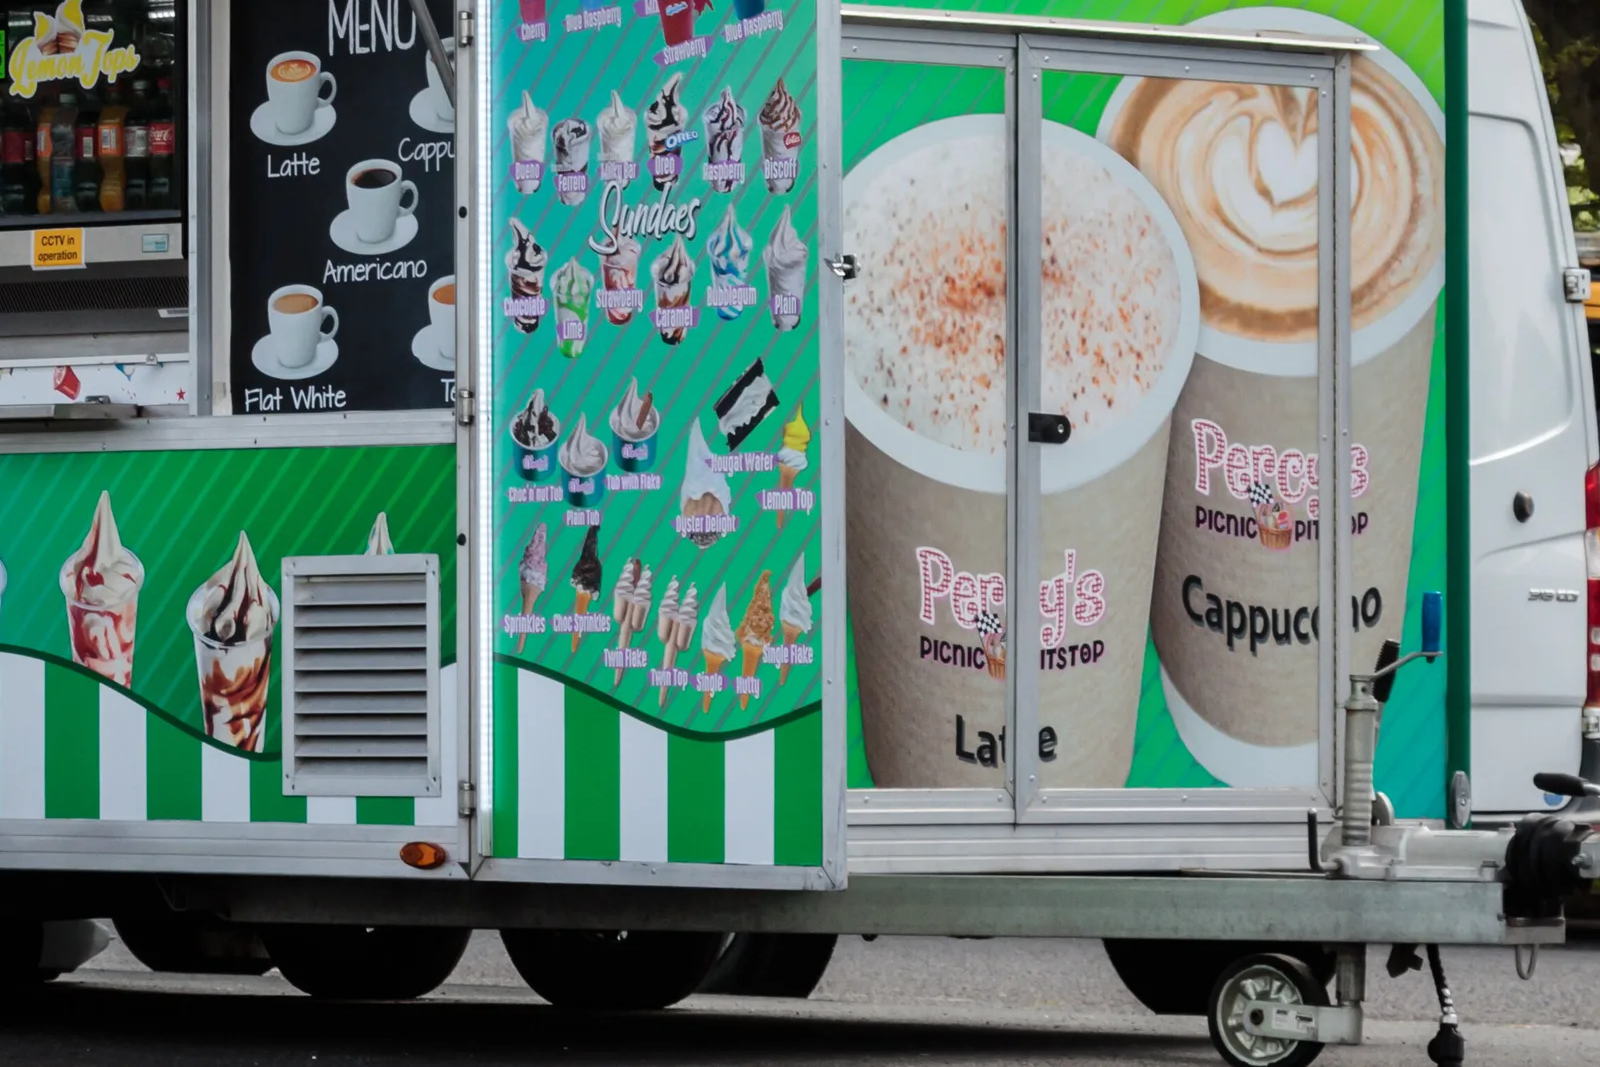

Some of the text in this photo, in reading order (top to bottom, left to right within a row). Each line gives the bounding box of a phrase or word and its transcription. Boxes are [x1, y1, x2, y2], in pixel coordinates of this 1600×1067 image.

[521, 22, 545, 42] Cherry
[725, 10, 783, 42] Blue Raspberry
[664, 37, 706, 64] Strawberry
[9, 28, 140, 99] Lemon Tops
[666, 131, 698, 148] OREO
[267, 153, 321, 178] Latte
[516, 163, 539, 180] Bueno
[655, 156, 674, 174] Oreo
[703, 163, 745, 184] Raspberry
[765, 159, 796, 179] Biscoff
[559, 176, 585, 191] Ferrero
[589, 182, 700, 255] Sundaes
[41, 235, 74, 246] CCTV in
[38, 250, 77, 262] operation
[323, 257, 427, 283] Americano
[504, 299, 545, 316] Chocolate
[596, 289, 643, 312] Strawberry
[775, 293, 797, 314] Plain
[655, 307, 693, 327] Caramel
[562, 321, 583, 340] Lime
[244, 385, 347, 412] Flat White
[711, 453, 774, 474] Nougat Wafer
[641, 474, 661, 489] Flake
[762, 489, 814, 515] Lemon Top
[567, 510, 599, 525] Plain Tub
[676, 517, 736, 537] Oyster Delight
[1196, 506, 1257, 539] PICNIC
[916, 546, 1105, 648] Pery's
[504, 614, 545, 637] Sprinkles
[554, 613, 611, 636] Choc Sprinkles
[604, 648, 647, 668] Twin Flake
[762, 645, 813, 668] Single Flake
[920, 636, 1105, 670] PICNIC ITSTOP
[650, 668, 688, 690] Twin Top
[696, 674, 722, 696] Single
[736, 677, 760, 698] Nutty
